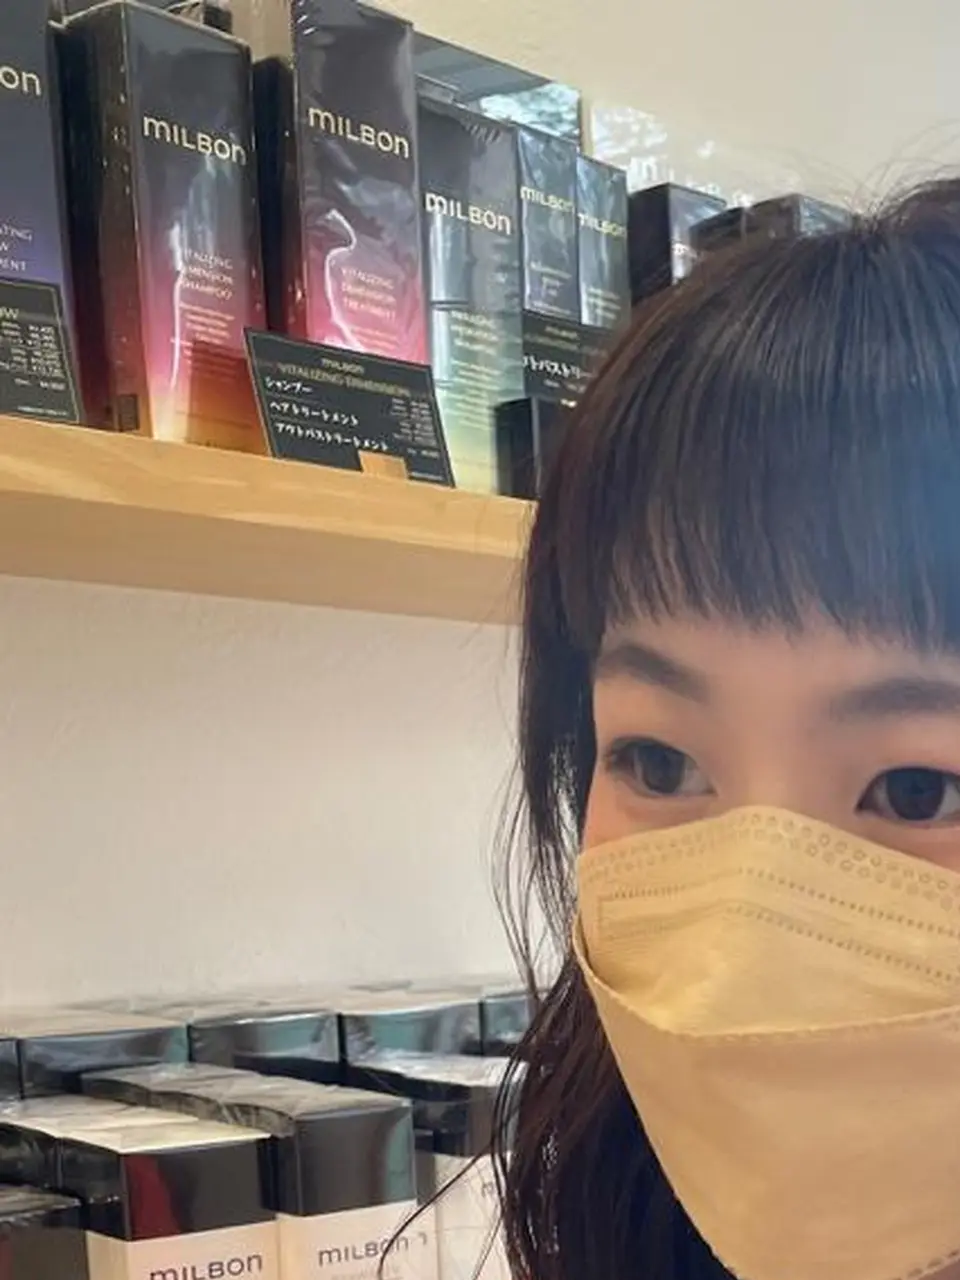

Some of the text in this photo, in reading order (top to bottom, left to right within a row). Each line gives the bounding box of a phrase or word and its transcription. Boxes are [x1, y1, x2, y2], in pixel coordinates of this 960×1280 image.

[269, 401, 360, 427] ヘアトリートメント
